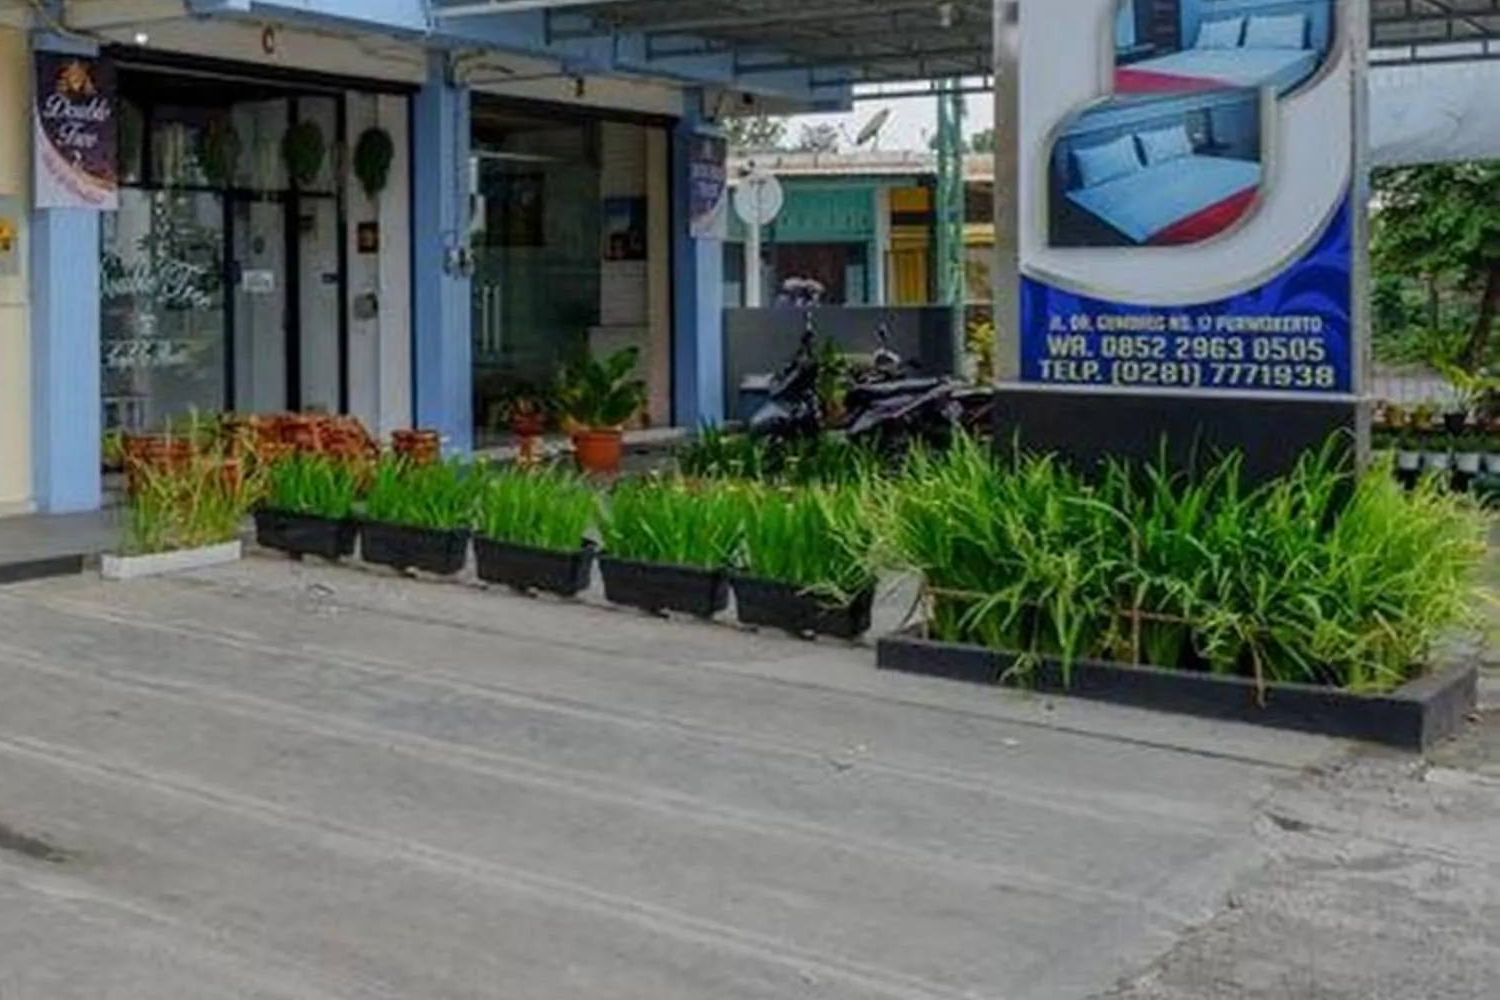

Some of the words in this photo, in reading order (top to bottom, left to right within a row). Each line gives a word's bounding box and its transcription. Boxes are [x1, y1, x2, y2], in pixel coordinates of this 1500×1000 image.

[262, 29, 275, 54] C
[1047, 334, 1093, 358] WA.
[1101, 336, 1166, 360] 0852
[1176, 337, 1244, 360] 2963
[1253, 337, 1325, 361] 0505
[1039, 360, 1101, 381] TELP.
[1111, 362, 1200, 387] (0281)
[1212, 364, 1335, 388] 7771938
